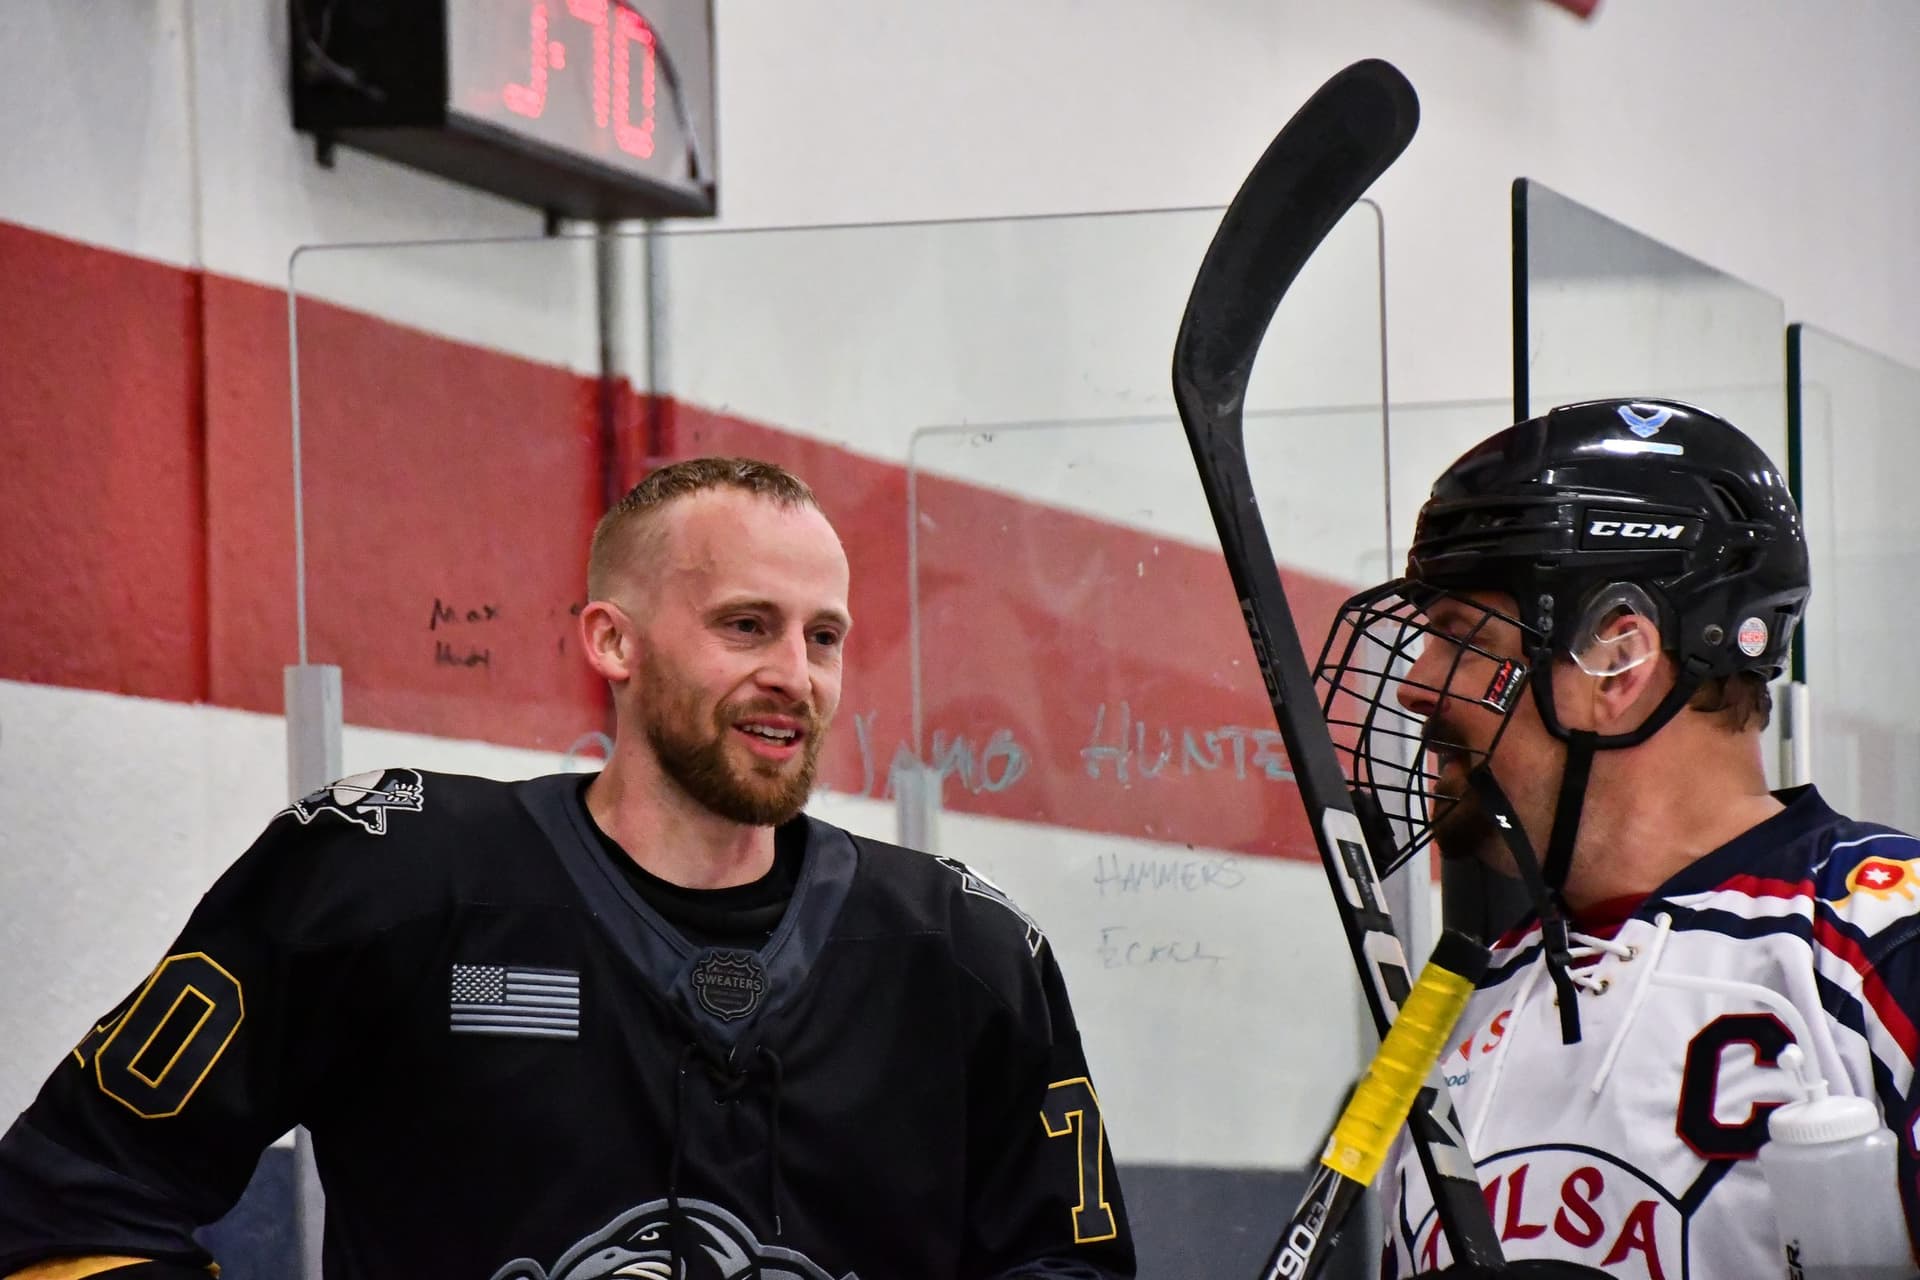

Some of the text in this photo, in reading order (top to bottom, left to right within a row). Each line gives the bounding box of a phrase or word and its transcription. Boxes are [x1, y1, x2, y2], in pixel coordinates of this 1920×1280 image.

[1589, 519, 1687, 541] CCM
[695, 972, 762, 992] SWEATERS
[1675, 1012, 1797, 1161] C
[1039, 1075, 1118, 1245] 7
